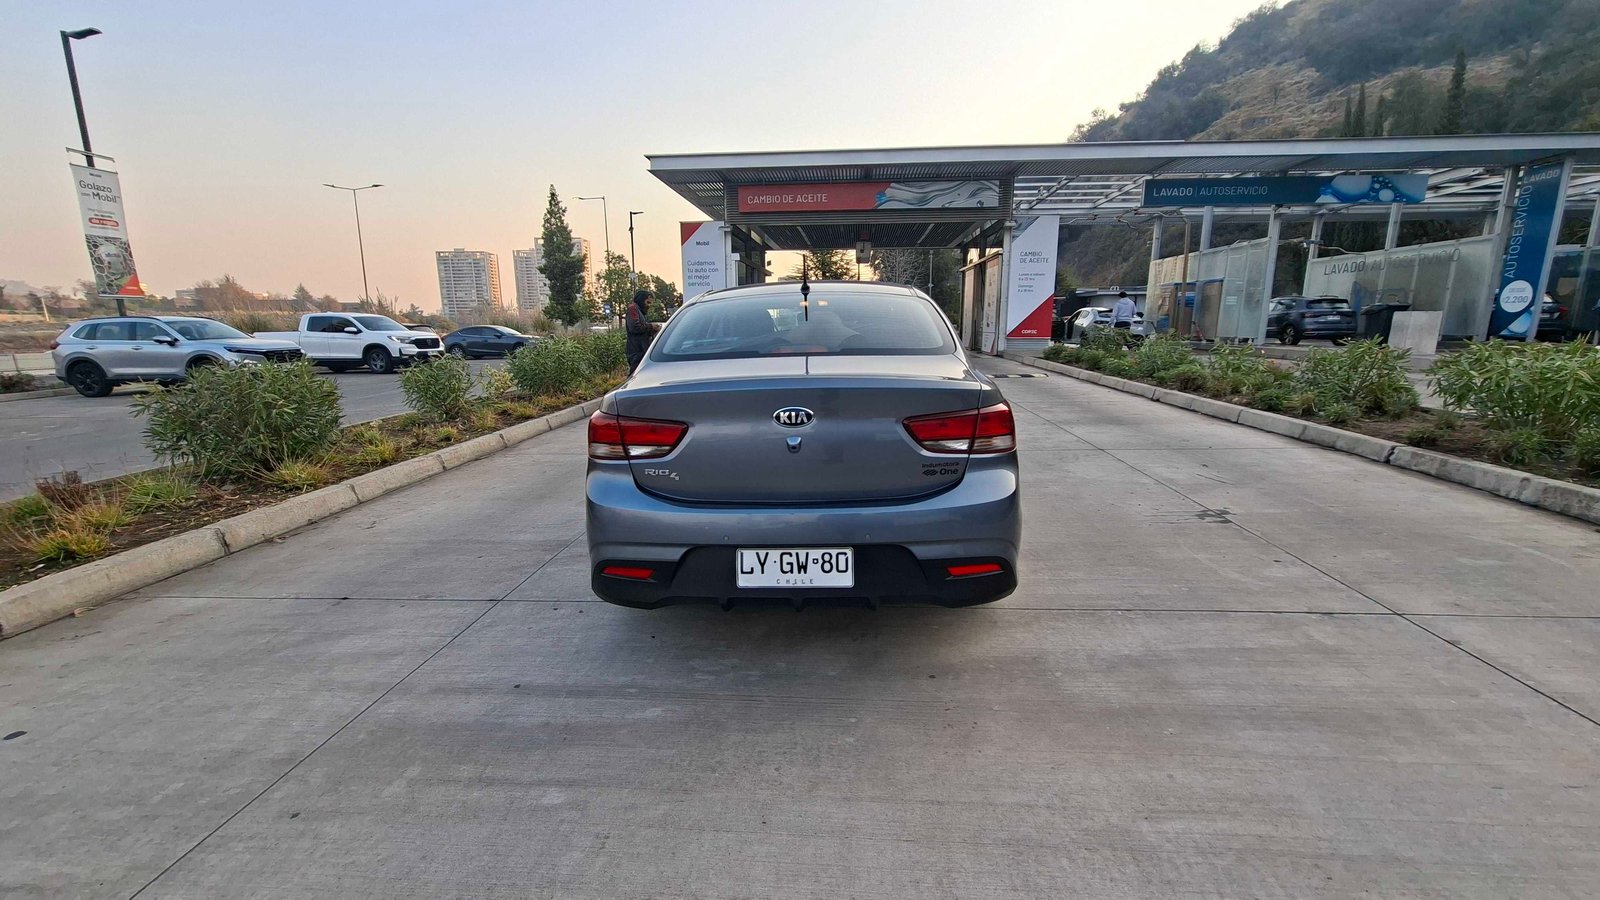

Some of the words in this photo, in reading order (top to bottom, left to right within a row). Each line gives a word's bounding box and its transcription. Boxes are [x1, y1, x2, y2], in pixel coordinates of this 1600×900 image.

[1523, 168, 1560, 184] LAVADO
[79, 179, 112, 193] Golazo
[1153, 187, 1193, 197] LAVADO
[1199, 185, 1268, 196] AUTOSERVICIO
[91, 191, 117, 203] Mobil
[747, 194, 781, 204] CAMBIO
[782, 194, 795, 203] DE
[796, 193, 828, 203] ACEITE
[1504, 185, 1533, 279] AUTOSERVICIO
[1323, 260, 1366, 276] LAVADO
[779, 411, 808, 424] KIA
